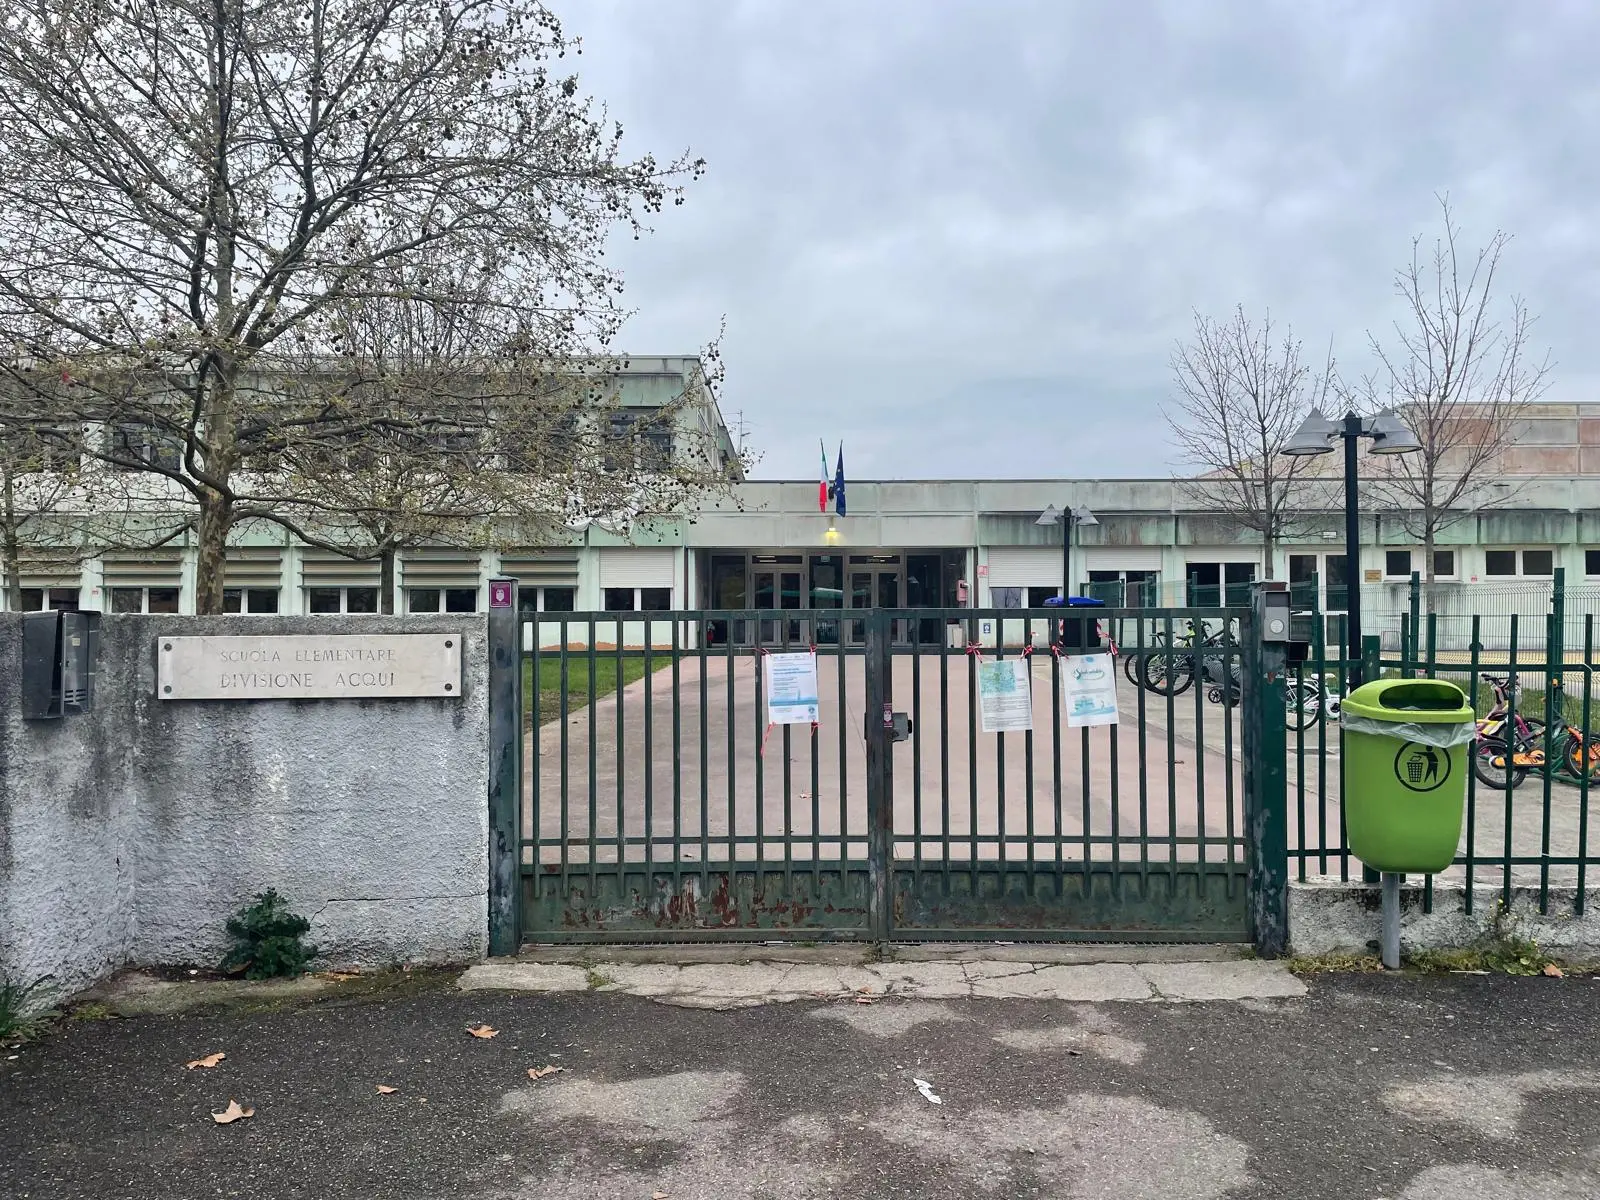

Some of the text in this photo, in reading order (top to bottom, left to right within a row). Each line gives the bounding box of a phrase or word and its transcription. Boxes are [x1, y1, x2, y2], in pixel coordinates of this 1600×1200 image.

[220, 648, 396, 662] SCUOLA ELEMENTARE
[220, 671, 395, 688] DIVISIONE ACQUI
